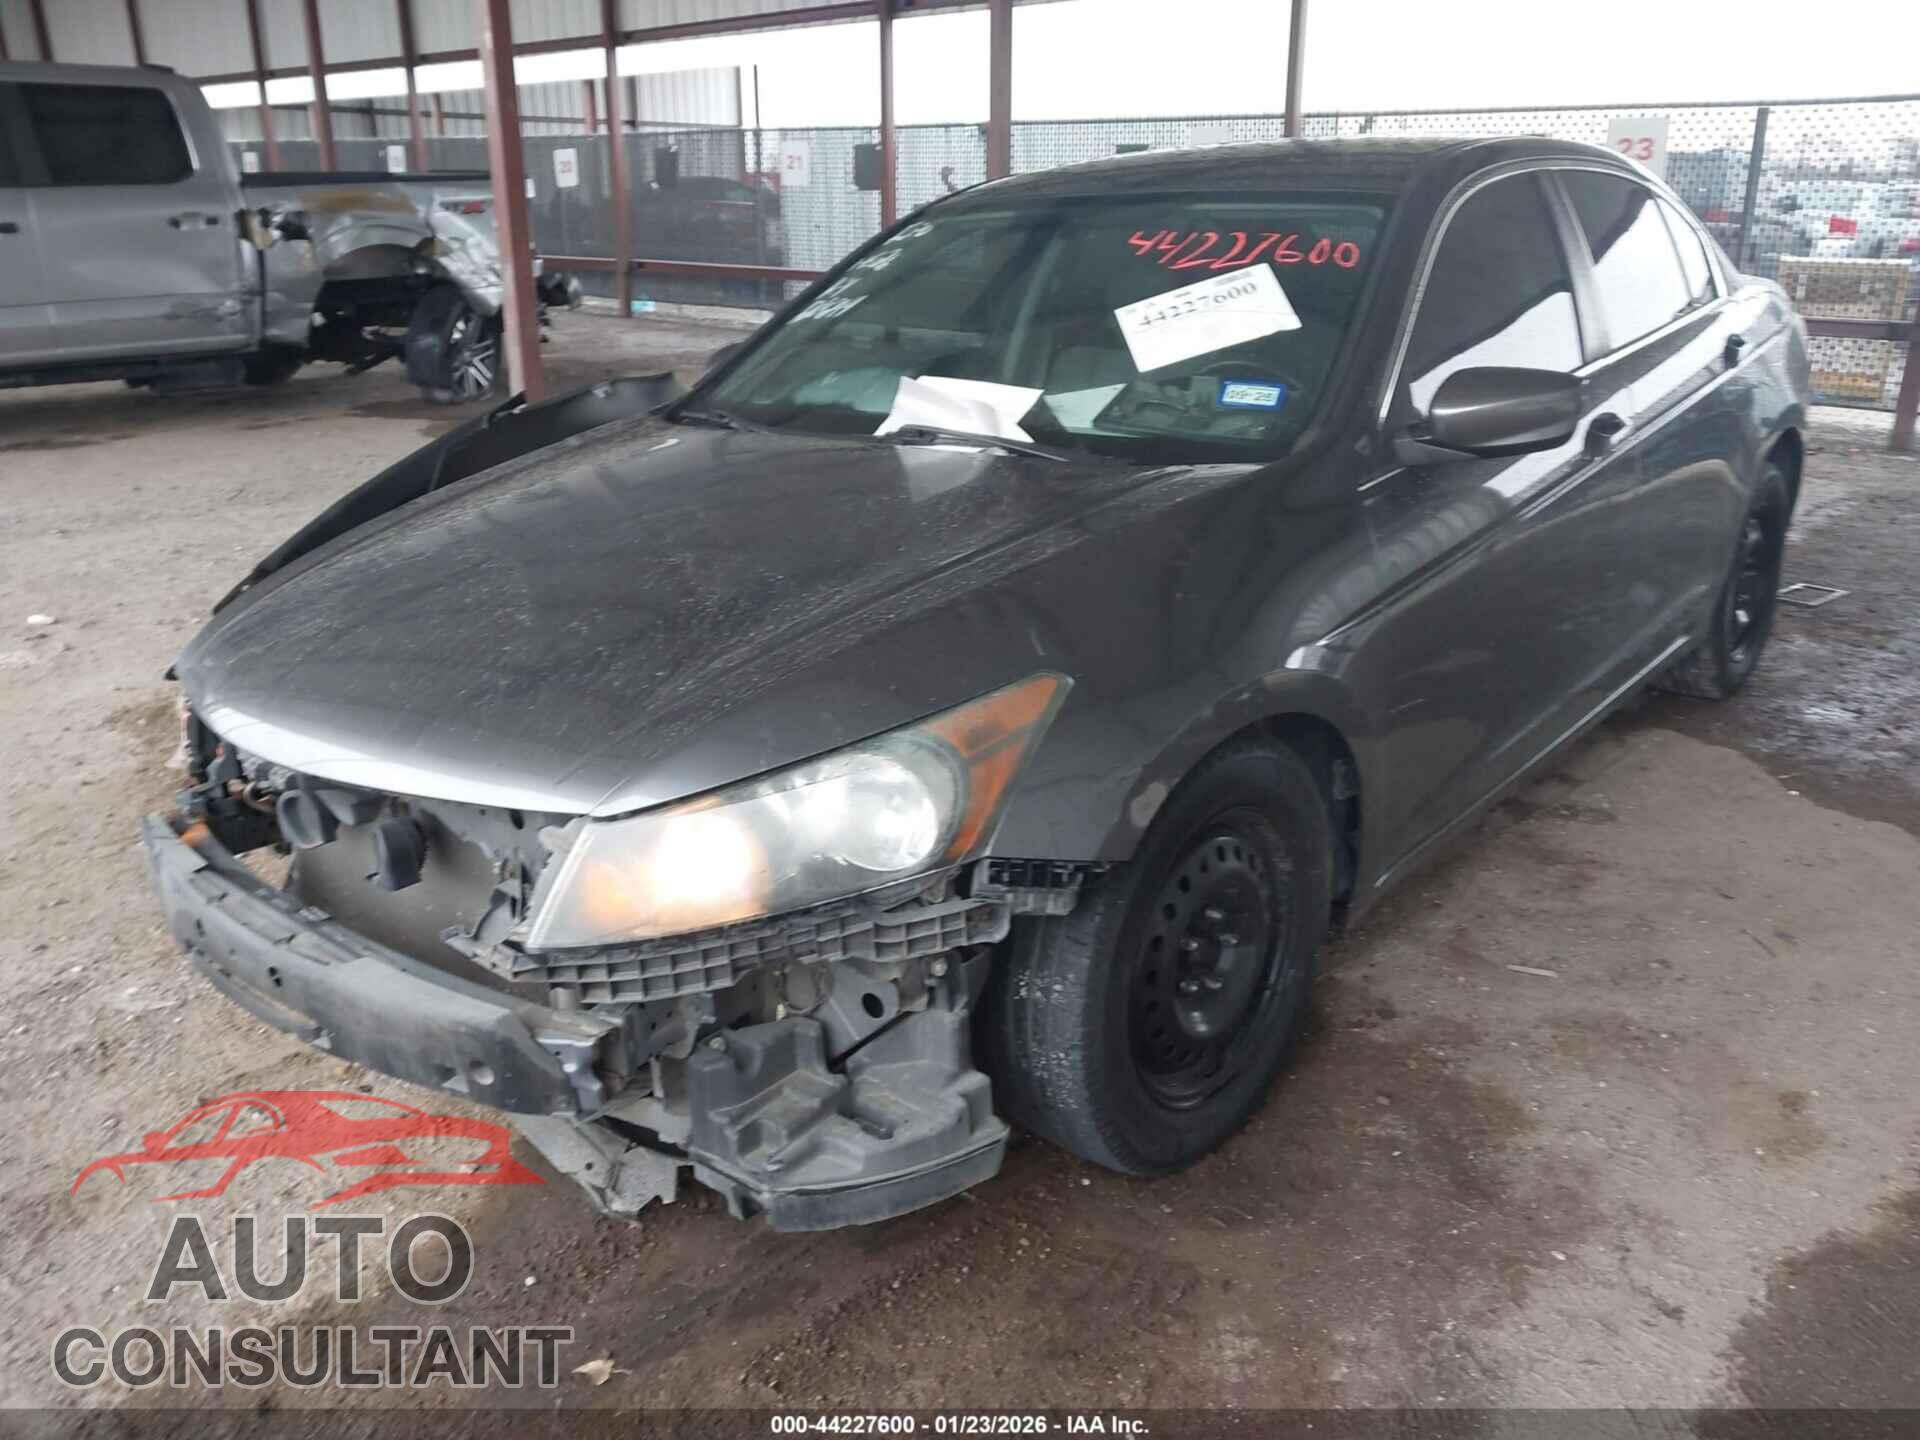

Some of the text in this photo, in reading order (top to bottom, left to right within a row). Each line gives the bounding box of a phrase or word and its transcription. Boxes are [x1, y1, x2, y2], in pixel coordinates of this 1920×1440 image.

[1618, 137, 1655, 161] 23
[1127, 229, 1361, 270] 44227600
[1137, 281, 1259, 327] 44227600
